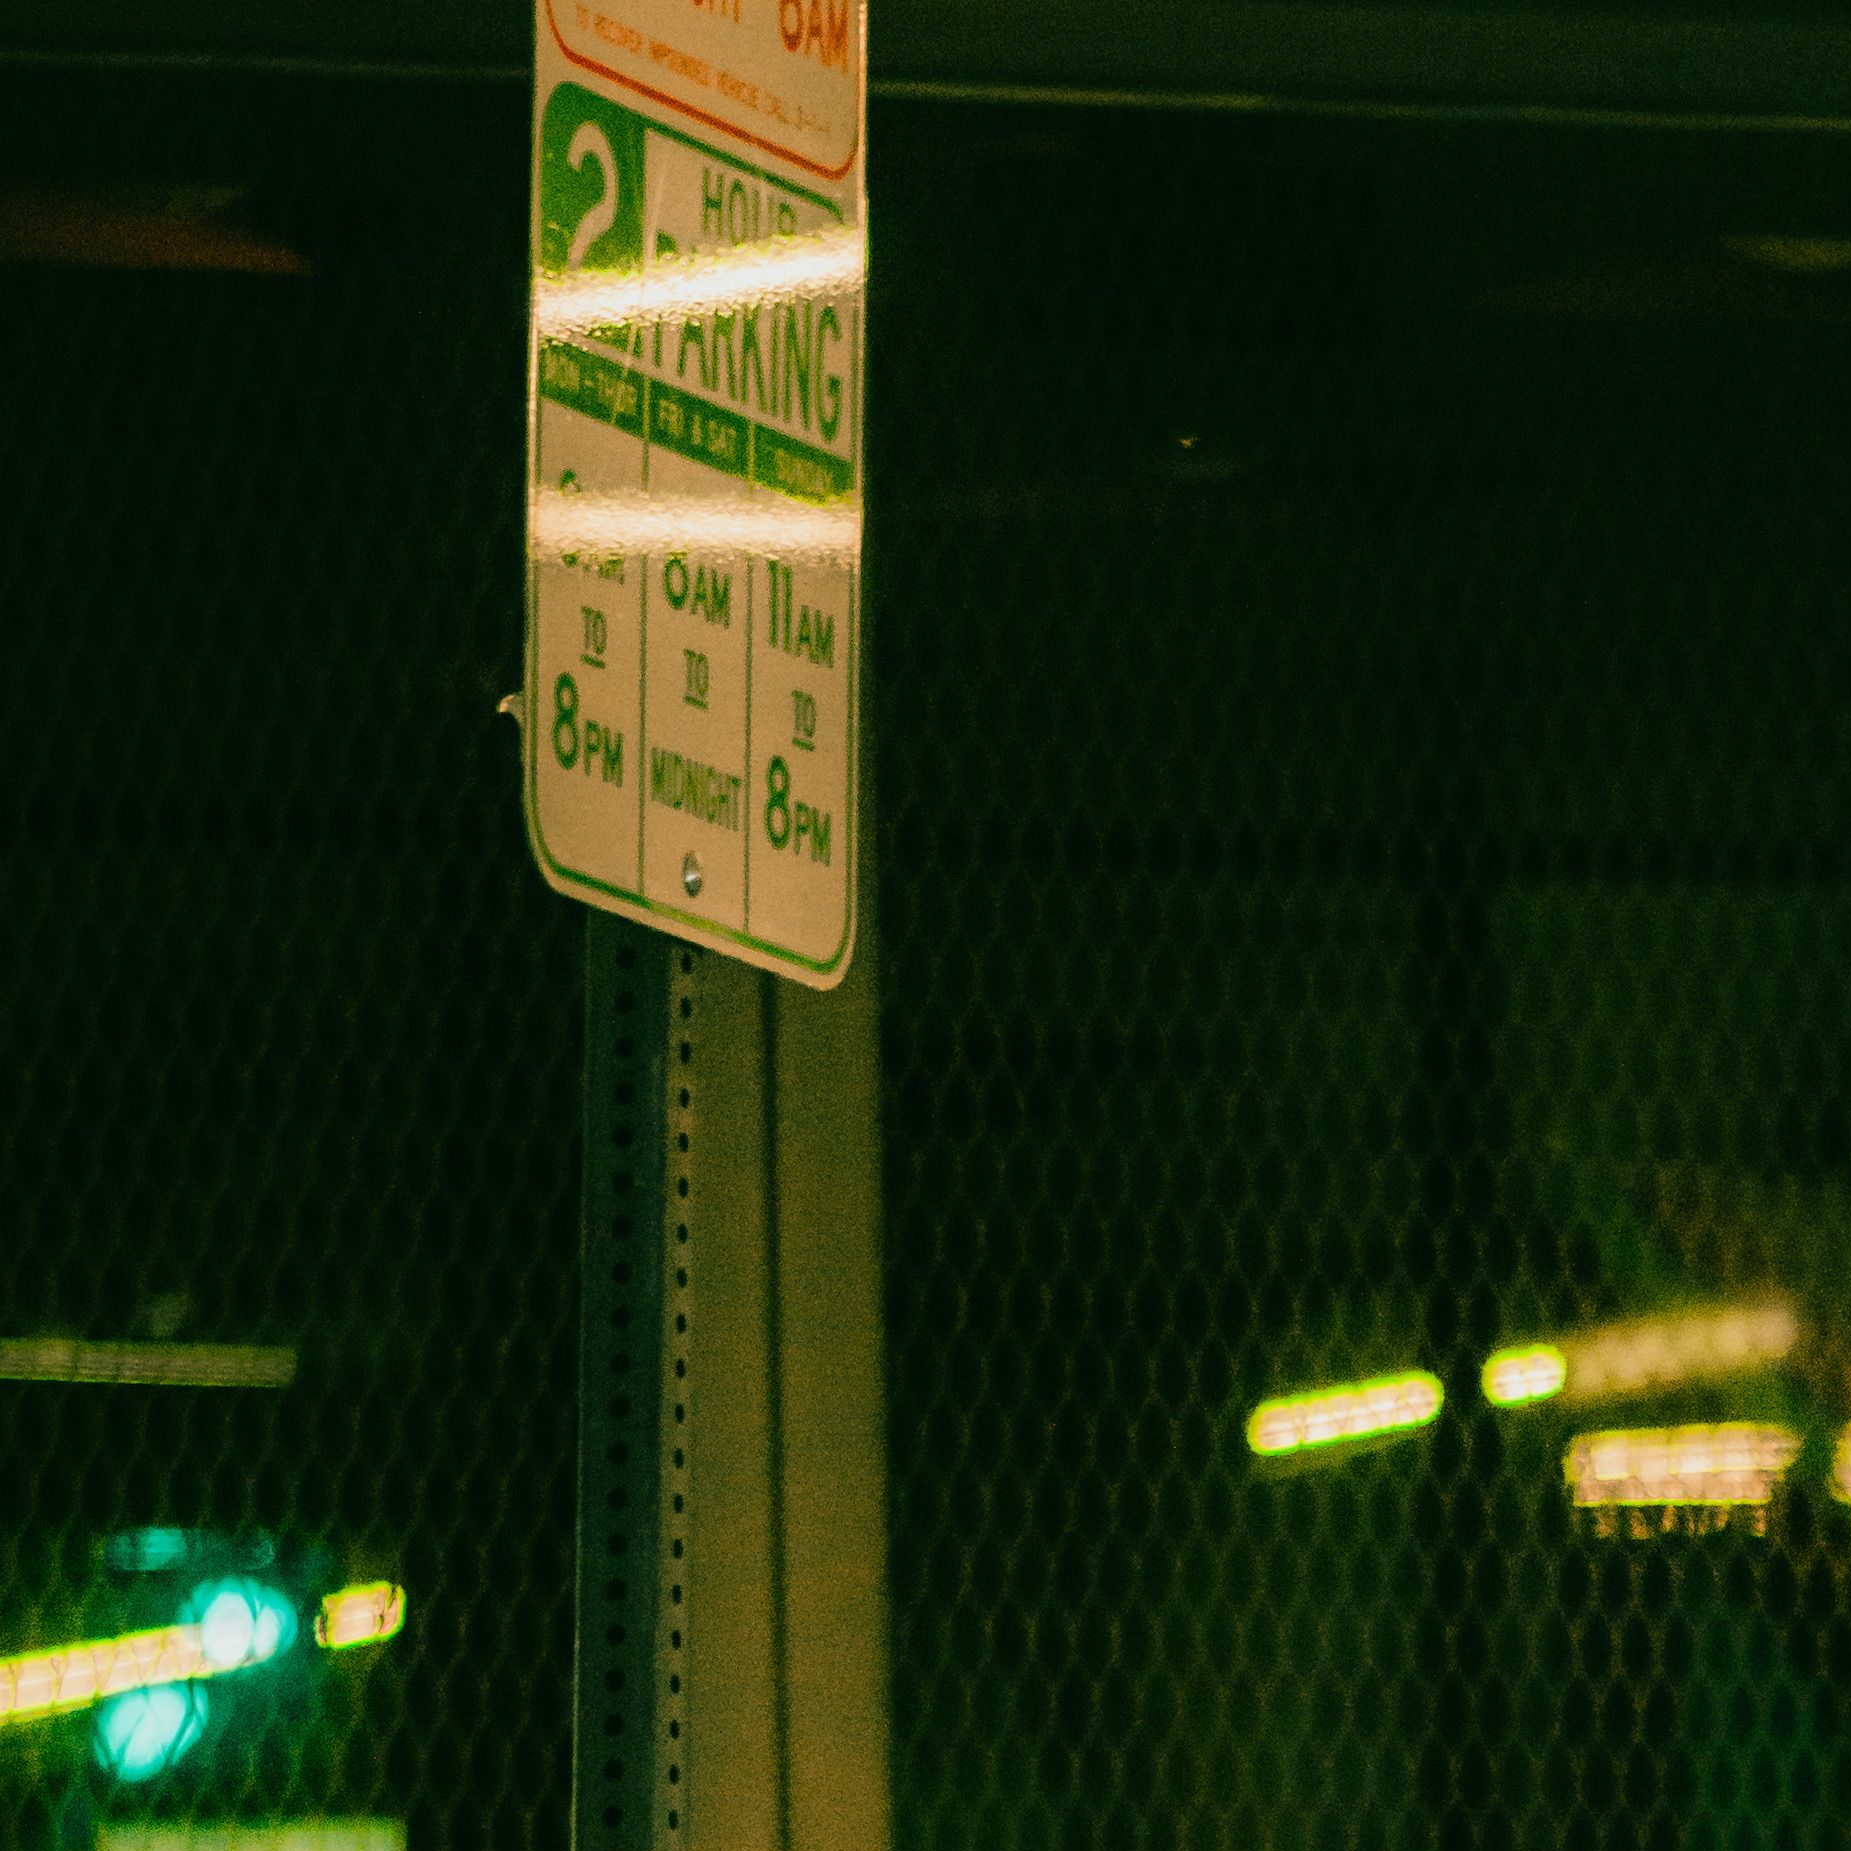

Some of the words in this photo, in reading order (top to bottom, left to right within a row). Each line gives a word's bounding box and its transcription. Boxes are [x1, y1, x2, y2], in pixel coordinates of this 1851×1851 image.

[567, 119, 620, 290] 2
[768, 558, 834, 669] 11AM
[551, 672, 624, 788] 8PM
[651, 747, 742, 832] MIDNIGHT
[766, 755, 833, 867] 8PM
